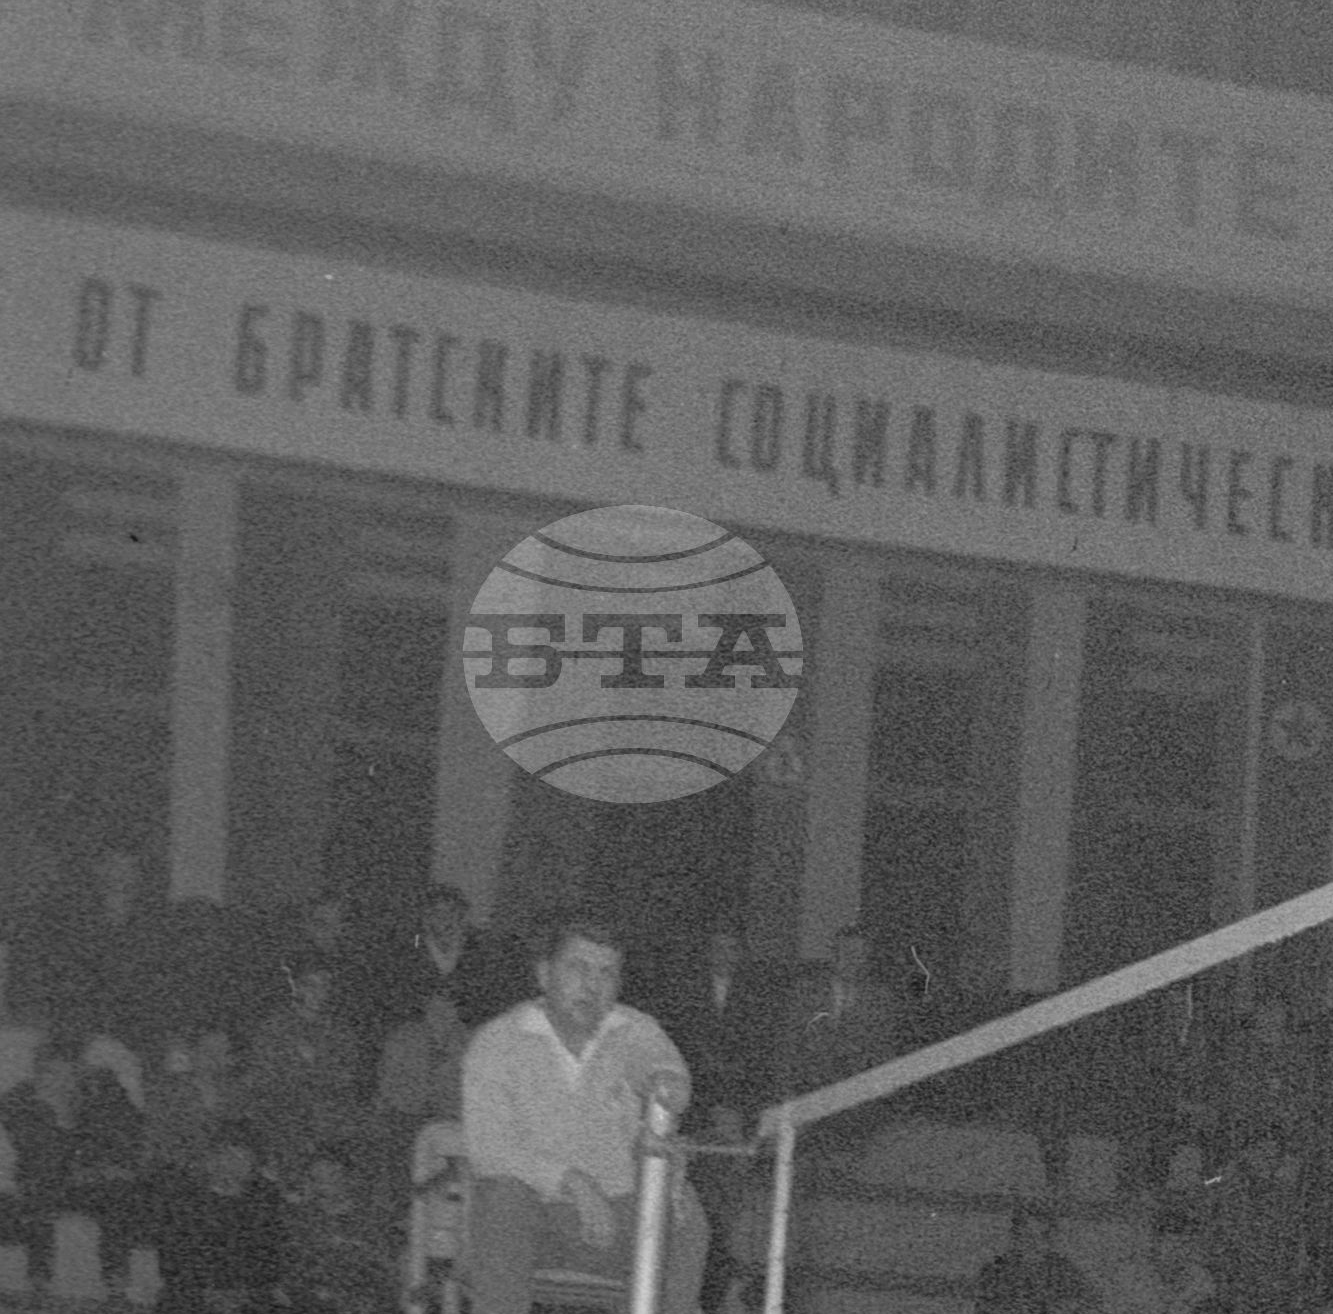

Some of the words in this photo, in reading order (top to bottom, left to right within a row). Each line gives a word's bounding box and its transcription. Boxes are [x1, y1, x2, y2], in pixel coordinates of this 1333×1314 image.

[652, 43, 1301, 242] НАРОДИТЕ
[71, 279, 163, 378] ОТ
[231, 298, 654, 454] БРАТСКИТЕ
